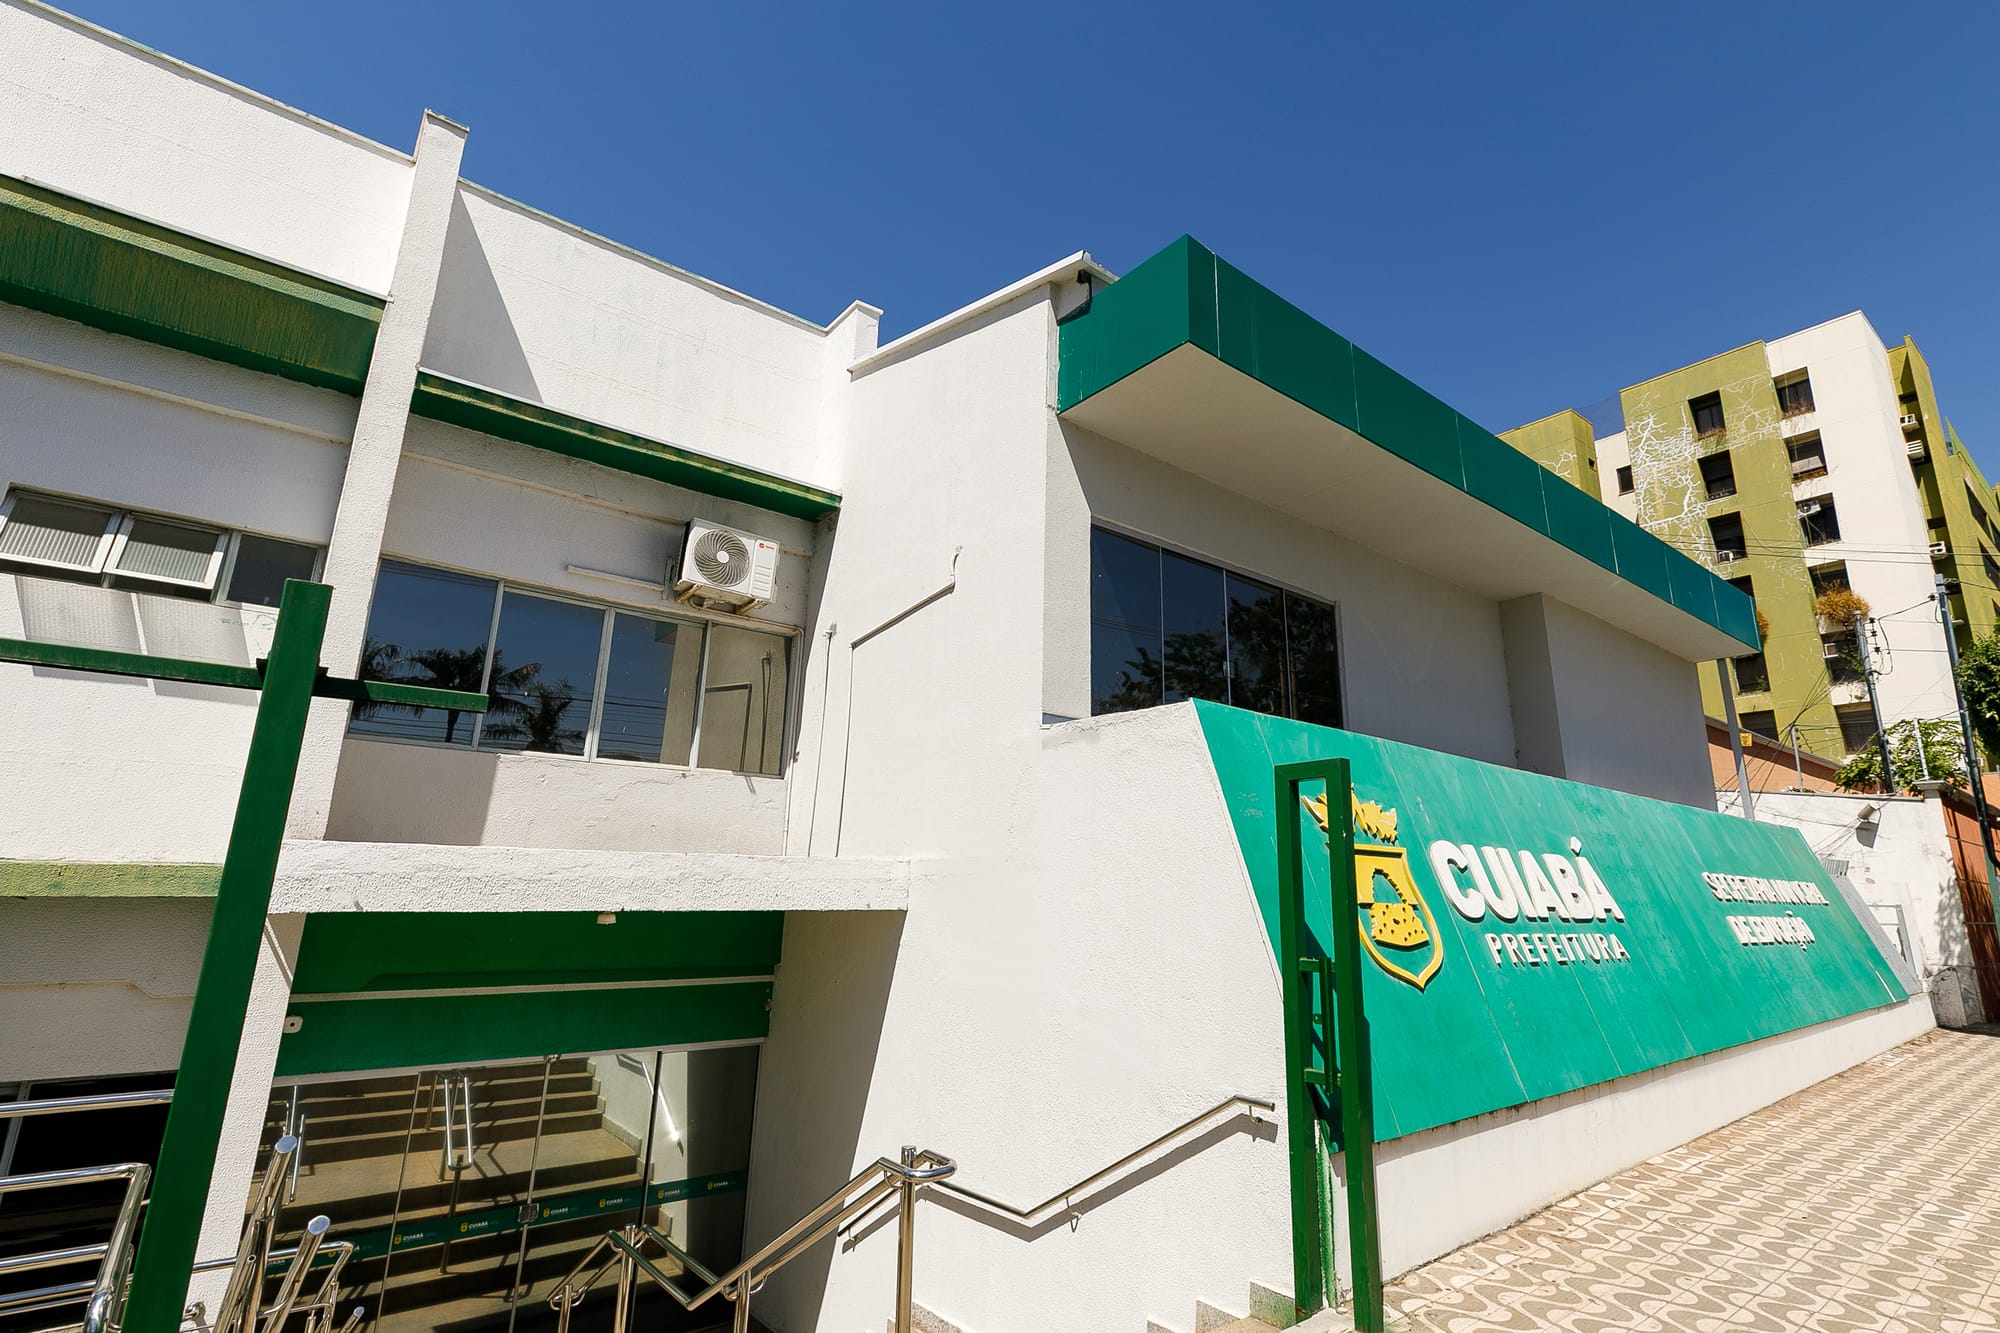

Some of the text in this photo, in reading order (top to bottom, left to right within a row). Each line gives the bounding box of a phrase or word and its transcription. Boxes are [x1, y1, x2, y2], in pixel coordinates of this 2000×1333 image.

[1430, 836, 1625, 922] CUIABÁ
[1484, 932, 1631, 966] PREFEITURA
[1726, 910, 1816, 952] DE EDUCAÇÃO
